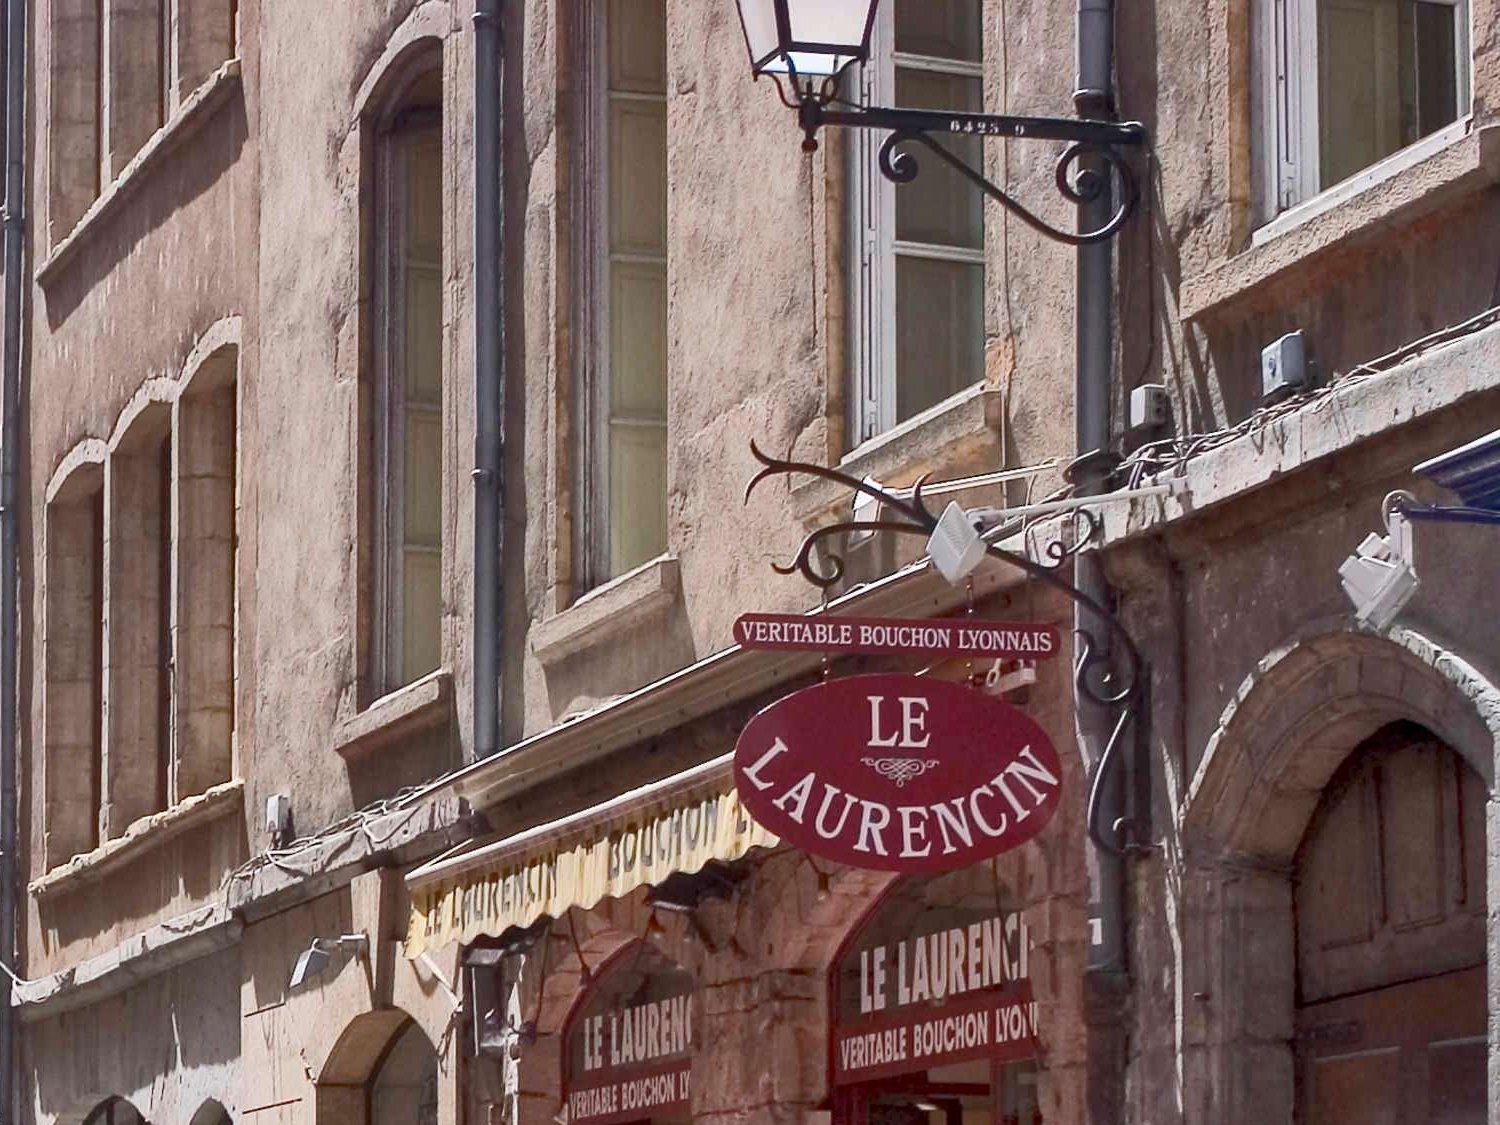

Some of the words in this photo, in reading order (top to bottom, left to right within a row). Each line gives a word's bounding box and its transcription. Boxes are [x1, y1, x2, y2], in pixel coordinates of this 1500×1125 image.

[741, 621, 852, 646] VERITABLE
[859, 625, 951, 648] BOUCHON
[958, 629, 1052, 652] LYONNAIS
[867, 695, 931, 748] LE
[742, 736, 1059, 858] LAURENCIN
[861, 945, 887, 1014] LE
[584, 1015, 603, 1071] LE
[841, 1026, 907, 1071] VERITABLE
[914, 1011, 988, 1058] BOUCHON
[570, 1084, 619, 1119] VERITABLE
[622, 1072, 676, 1110] BOUCHON
